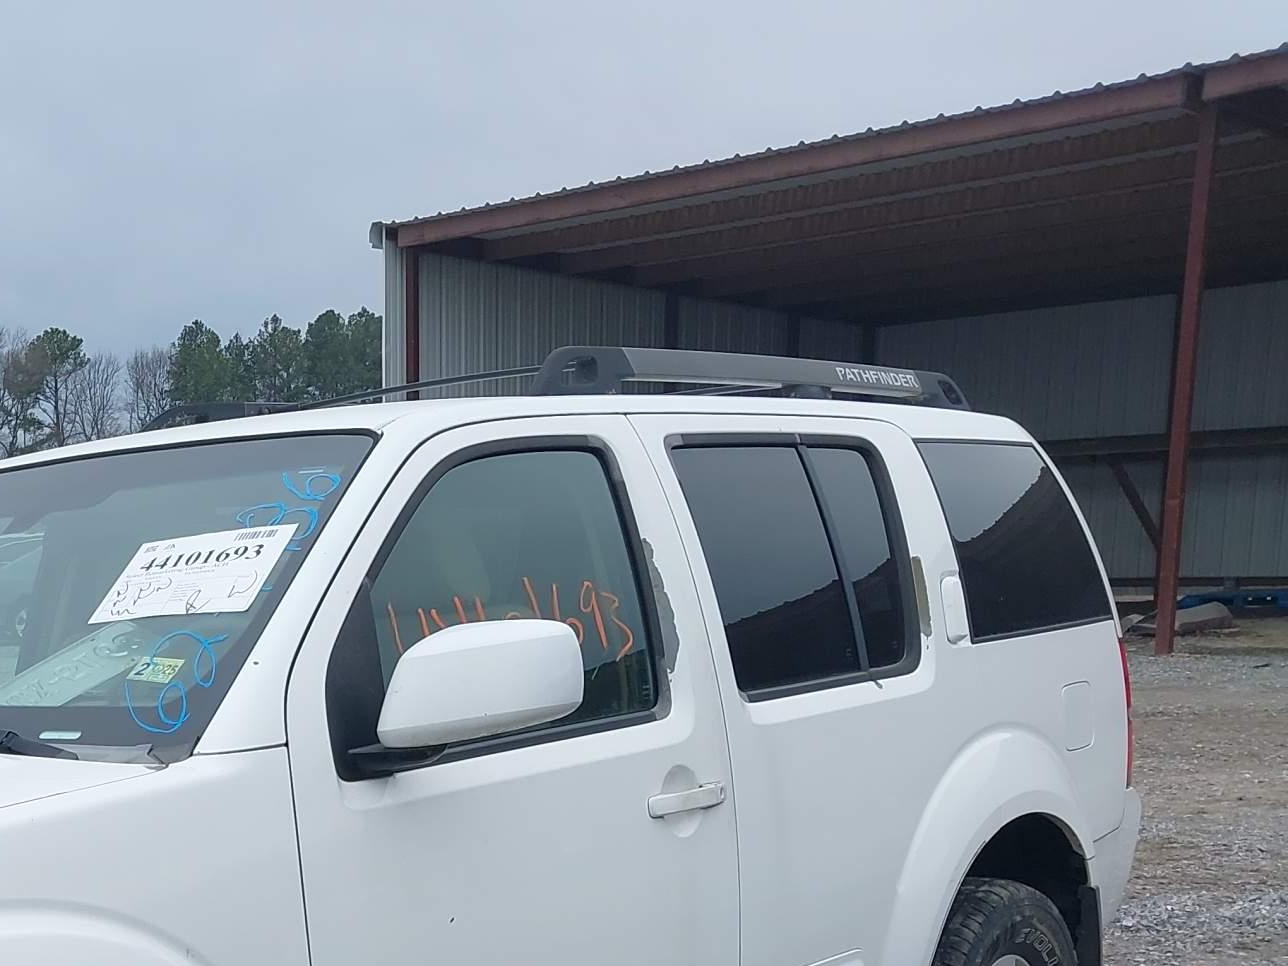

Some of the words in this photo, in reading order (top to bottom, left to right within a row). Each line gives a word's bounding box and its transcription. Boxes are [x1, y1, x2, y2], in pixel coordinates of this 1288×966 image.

[835, 367, 920, 389] PATHFINDER
[139, 543, 265, 572] 44101693
[133, 662, 151, 676] 2
